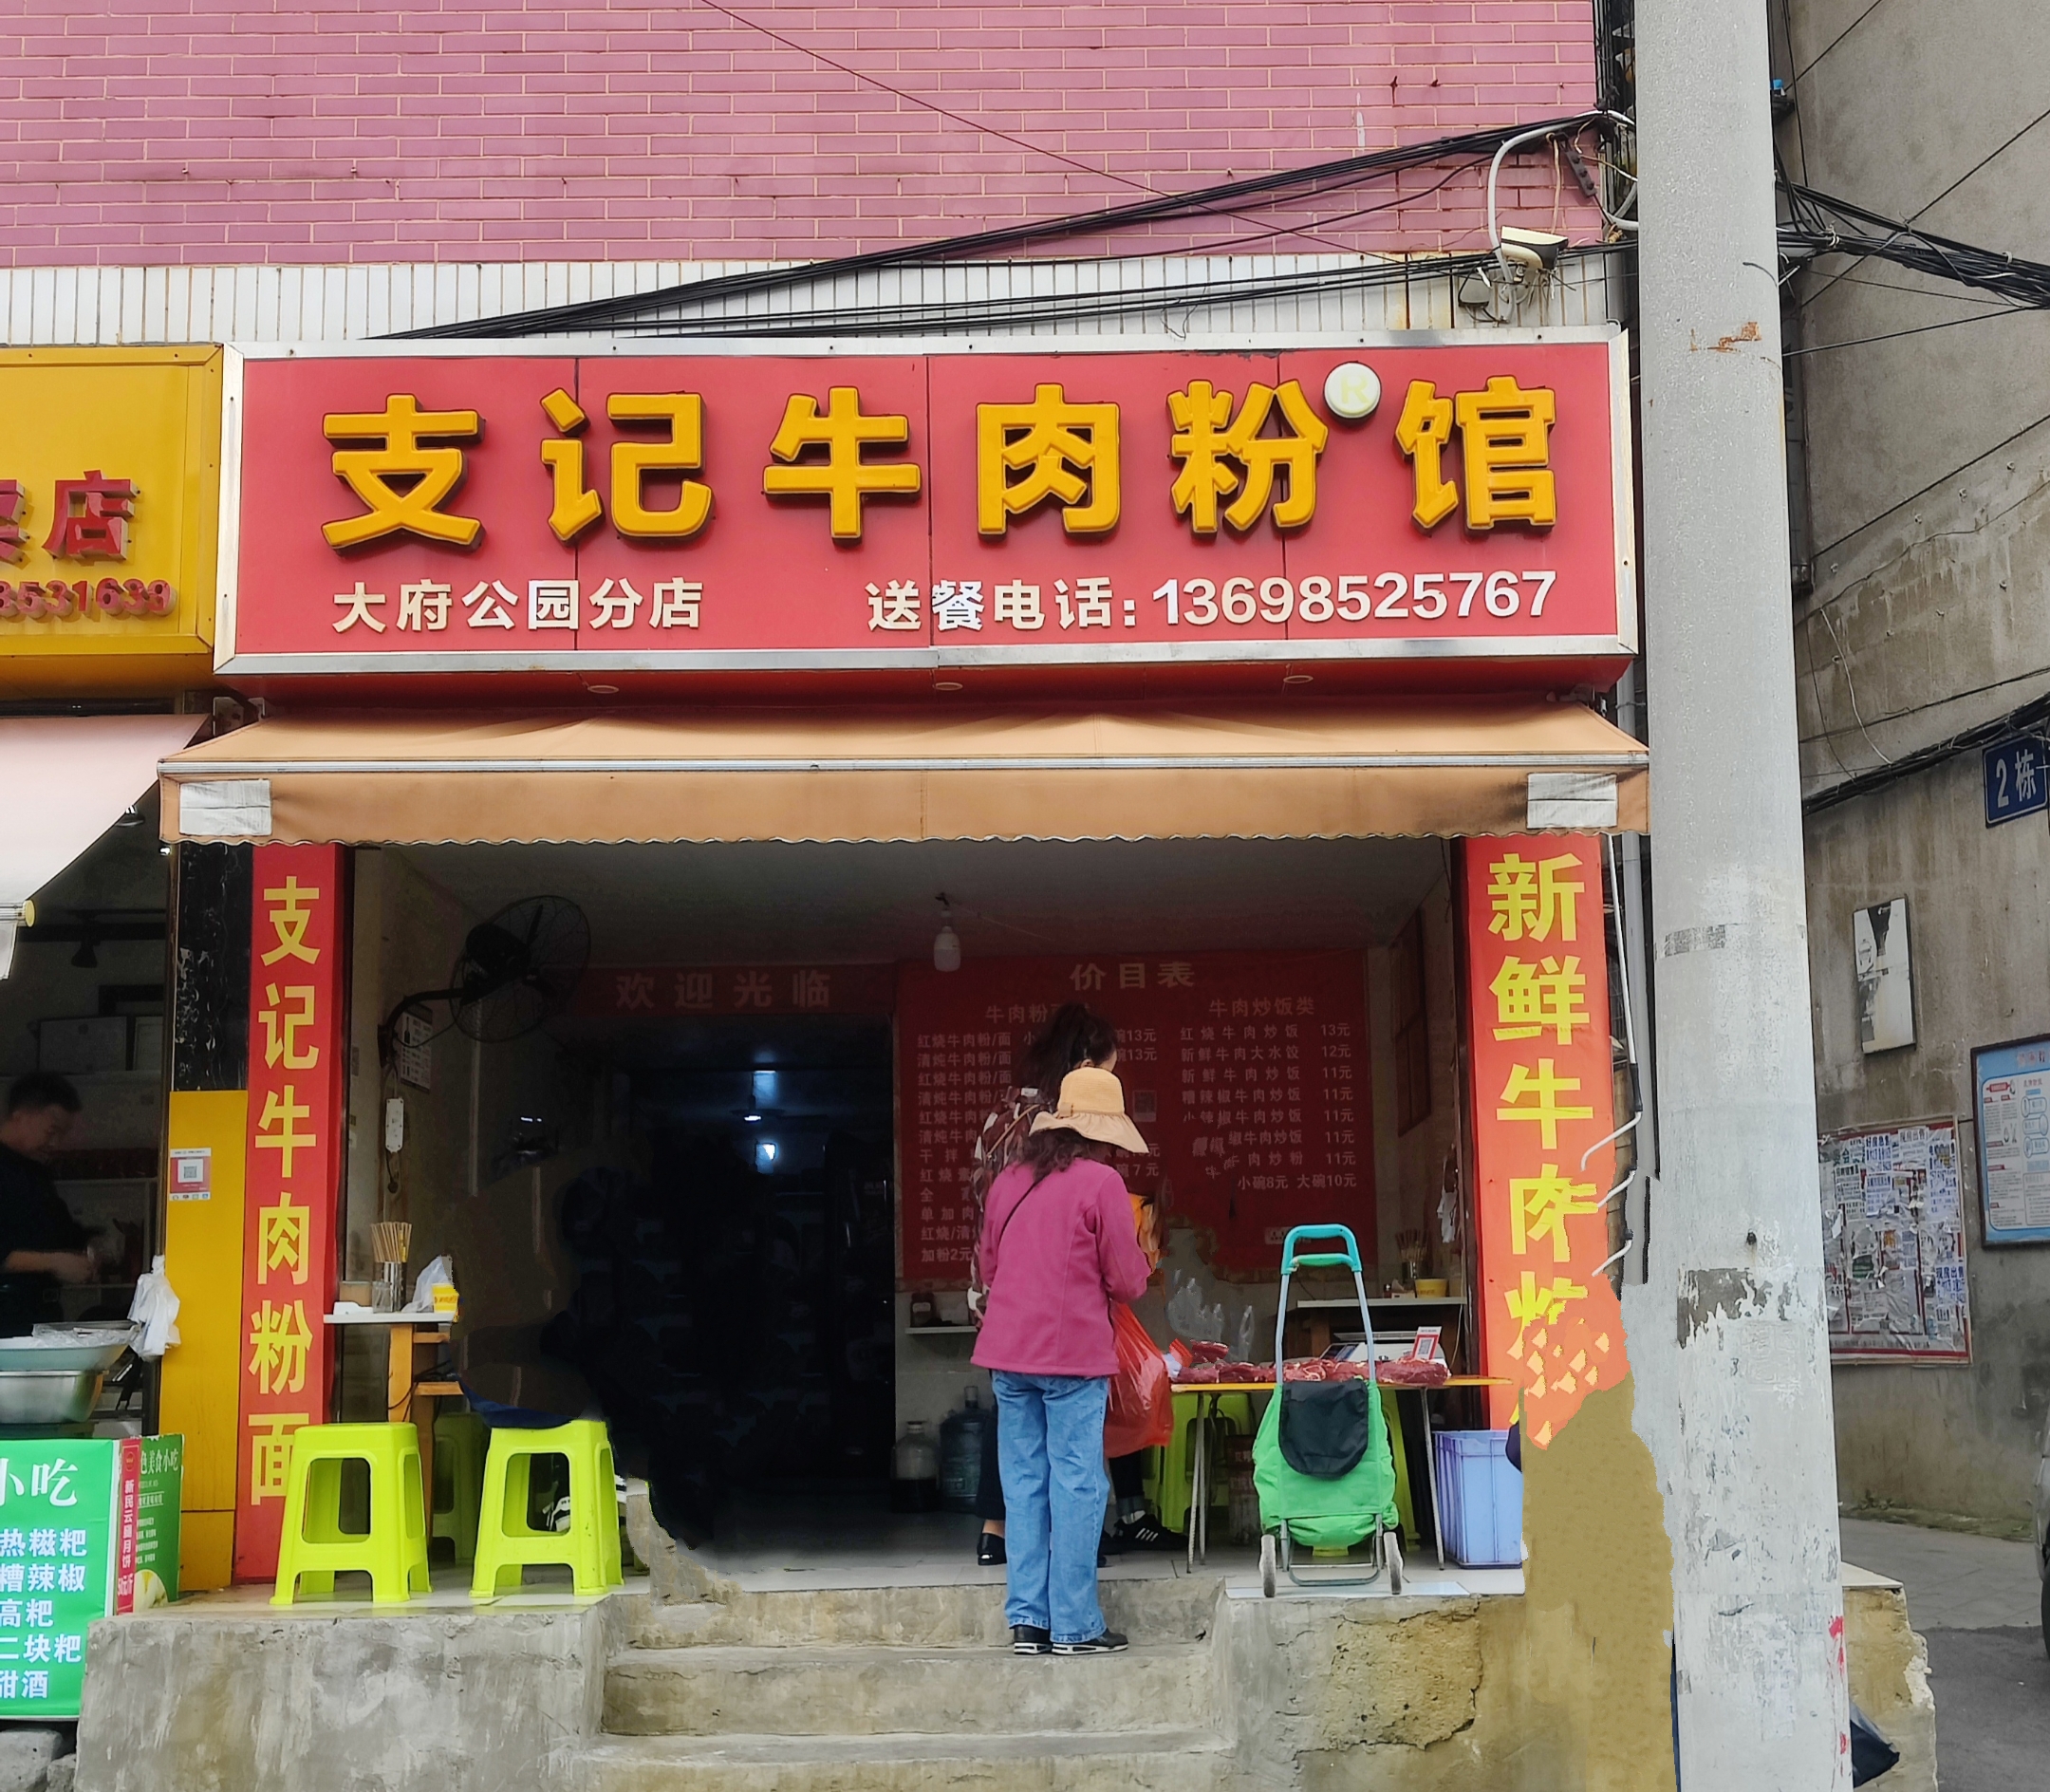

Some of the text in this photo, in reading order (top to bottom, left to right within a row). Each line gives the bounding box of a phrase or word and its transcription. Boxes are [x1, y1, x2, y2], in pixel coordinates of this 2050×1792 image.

[321, 374, 1557, 552] 支记牛肉粉馆
[332, 576, 703, 633] 大府公园分店
[1070, 961, 1197, 991] 价目表
[615, 968, 832, 1011] 欢迎光临
[1208, 997, 1314, 1017] 牛肉炒饭类
[917, 1032, 1012, 1048] 红烧牛肉粉/面
[1180, 1022, 1351, 1041] 红烧牛肉炒饭 13元
[1181, 1043, 1352, 1062] 新鲜牛肉大水饺 12元
[918, 1070, 1013, 1086] 红烧牛肉粉/面
[1182, 1064, 1352, 1083] 新鲜牛肉炒饭 11元
[1323, 1086, 1354, 1101] 11元
[1324, 1108, 1354, 1123] 11元
[1486, 851, 1600, 1361] 新鲜牛肉
[1325, 1129, 1355, 1144] 11元
[920, 1148, 975, 1164] 干拌
[1325, 1150, 1356, 1166] 11元
[248, 875, 322, 1506] 支记牛肉粉面
[1238, 1172, 1357, 1191] 小碗8元 大碗10元
